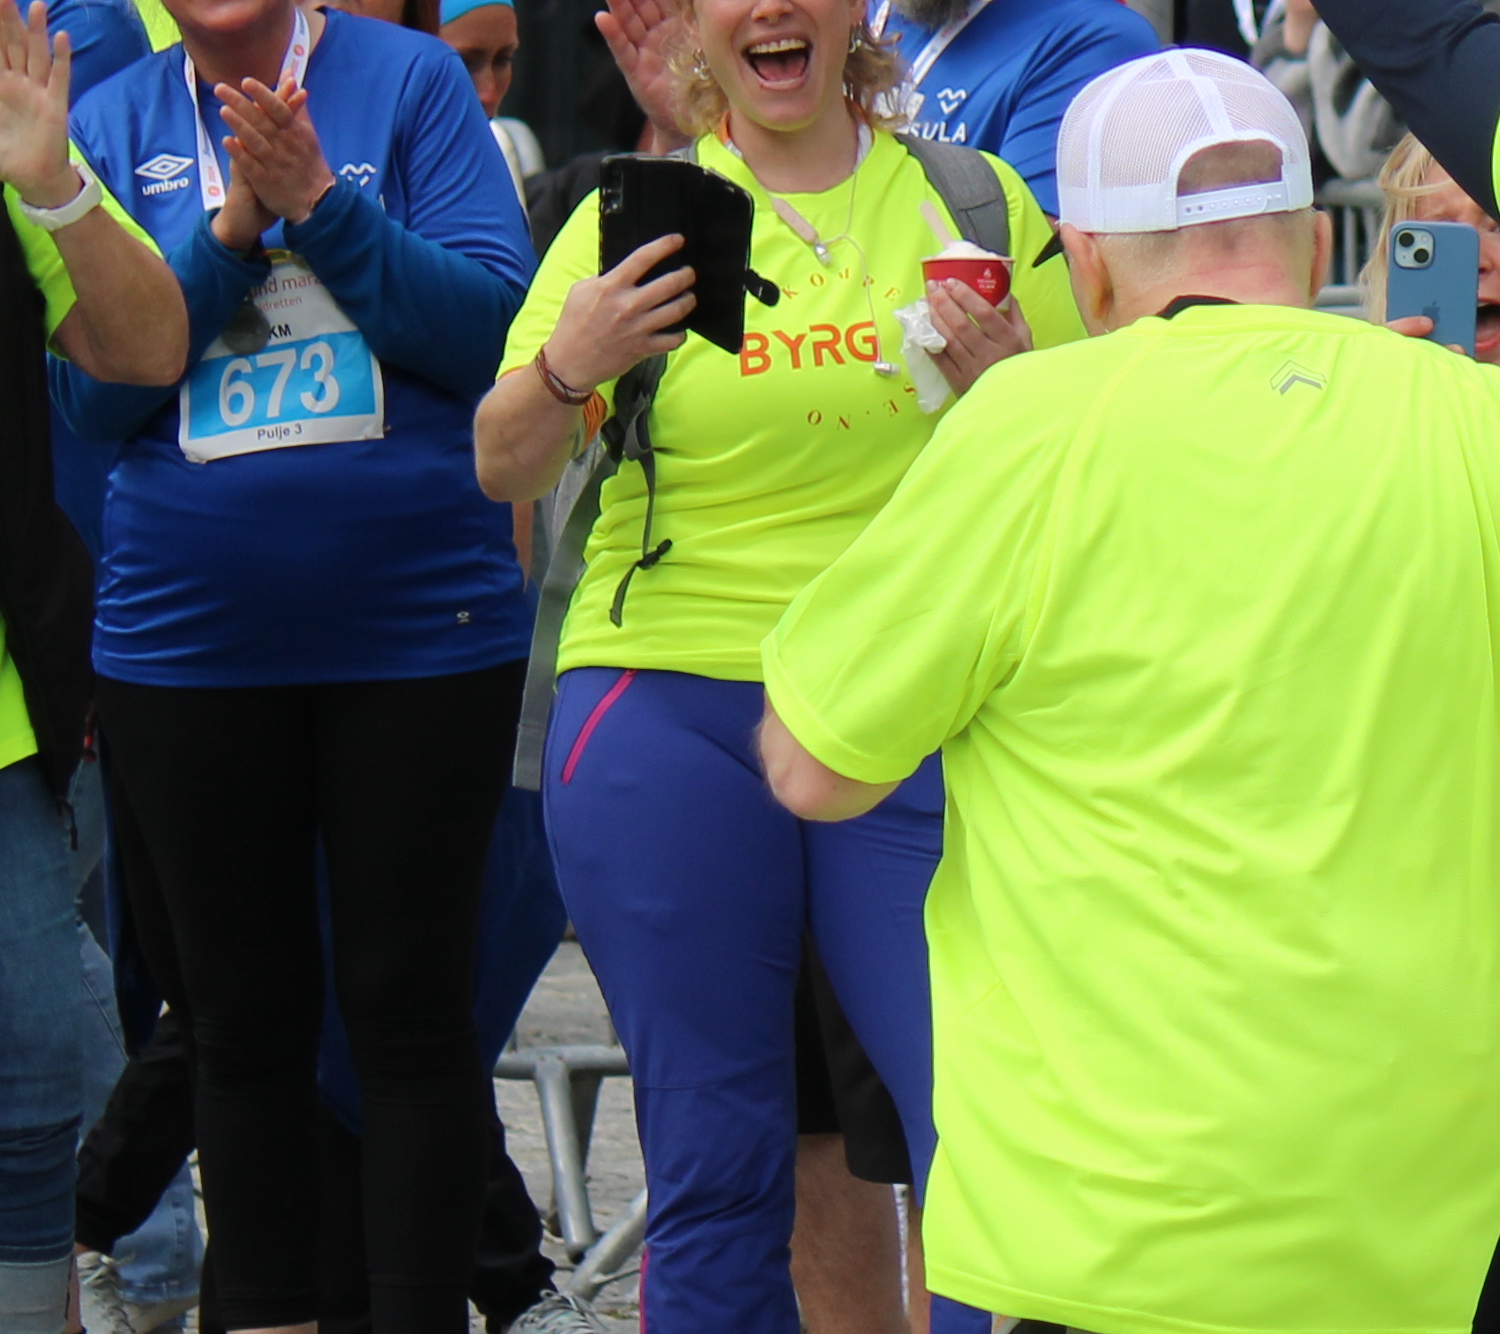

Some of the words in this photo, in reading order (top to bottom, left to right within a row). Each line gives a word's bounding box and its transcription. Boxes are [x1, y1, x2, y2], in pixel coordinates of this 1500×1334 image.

[142, 176, 190, 196] umbro
[268, 323, 293, 340] KM
[740, 320, 879, 378] BYRG
[219, 341, 340, 427] 673
[257, 426, 291, 441] Pulje
[294, 424, 303, 435] 3
